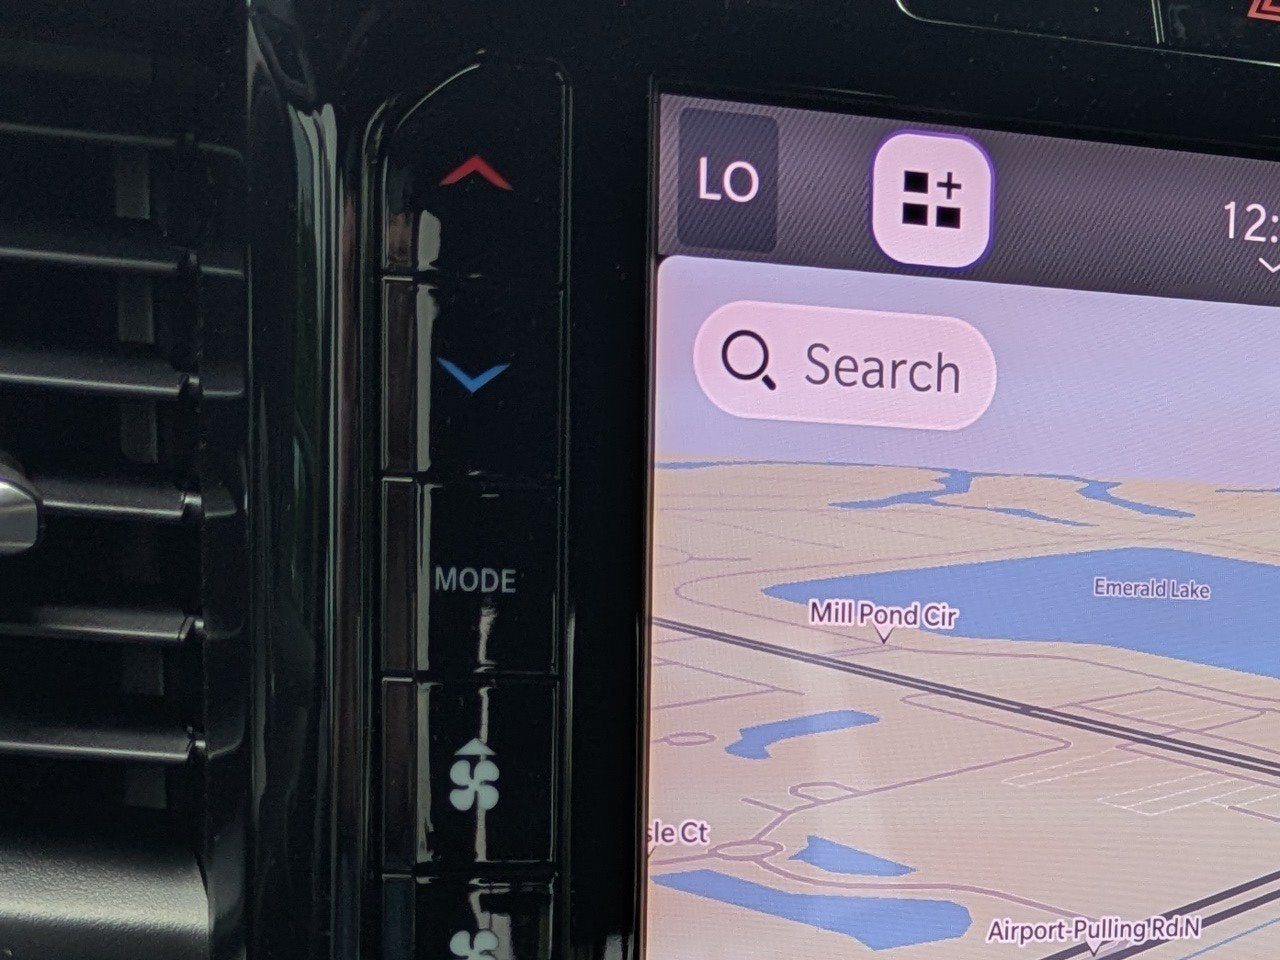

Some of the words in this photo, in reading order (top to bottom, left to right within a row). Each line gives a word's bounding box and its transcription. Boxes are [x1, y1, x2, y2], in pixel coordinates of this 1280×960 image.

[698, 156, 760, 204] LO
[804, 342, 961, 395] Search
[434, 566, 517, 594] MODE
[1094, 577, 1167, 598] Emerald
[1169, 579, 1211, 600] Lake
[809, 601, 854, 625] Mill
[859, 601, 919, 626] Pond
[923, 603, 957, 629] Cir
[681, 821, 708, 843] Ct
[987, 918, 1146, 945] Airport-Pulling
[1151, 918, 1178, 938] Rd
[1184, 918, 1200, 937] N
